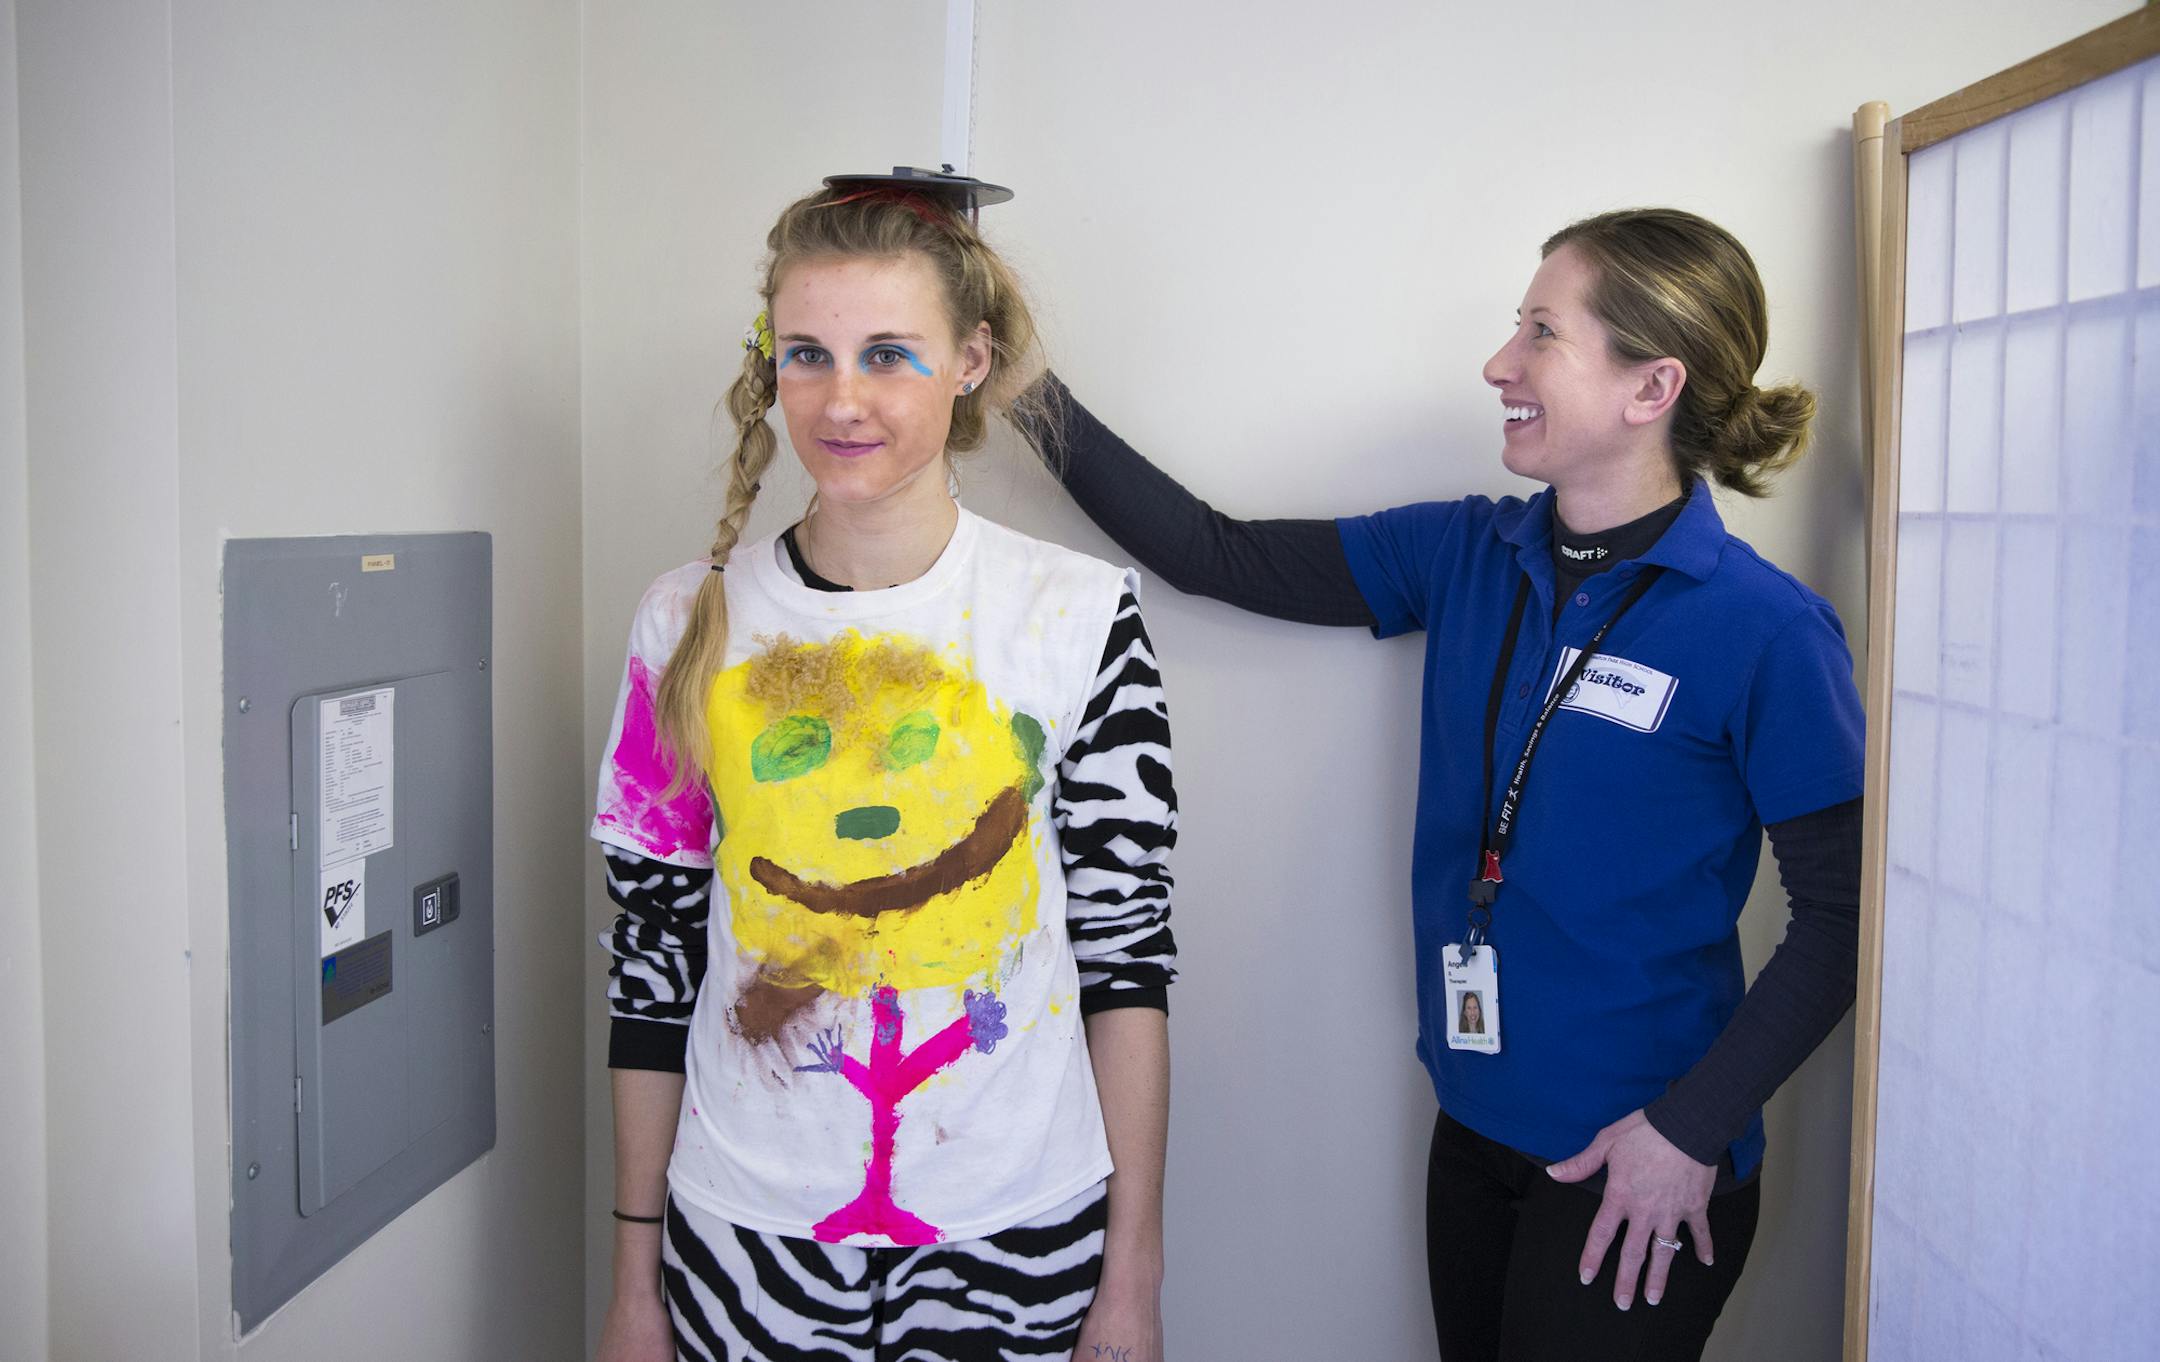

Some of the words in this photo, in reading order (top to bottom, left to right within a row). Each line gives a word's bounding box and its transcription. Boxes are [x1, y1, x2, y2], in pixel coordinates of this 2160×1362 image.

[1580, 668, 1645, 696] Visitor
[1501, 800, 1513, 821] FIT
[1498, 821, 1509, 835] BE
[324, 879, 354, 908] PFS
